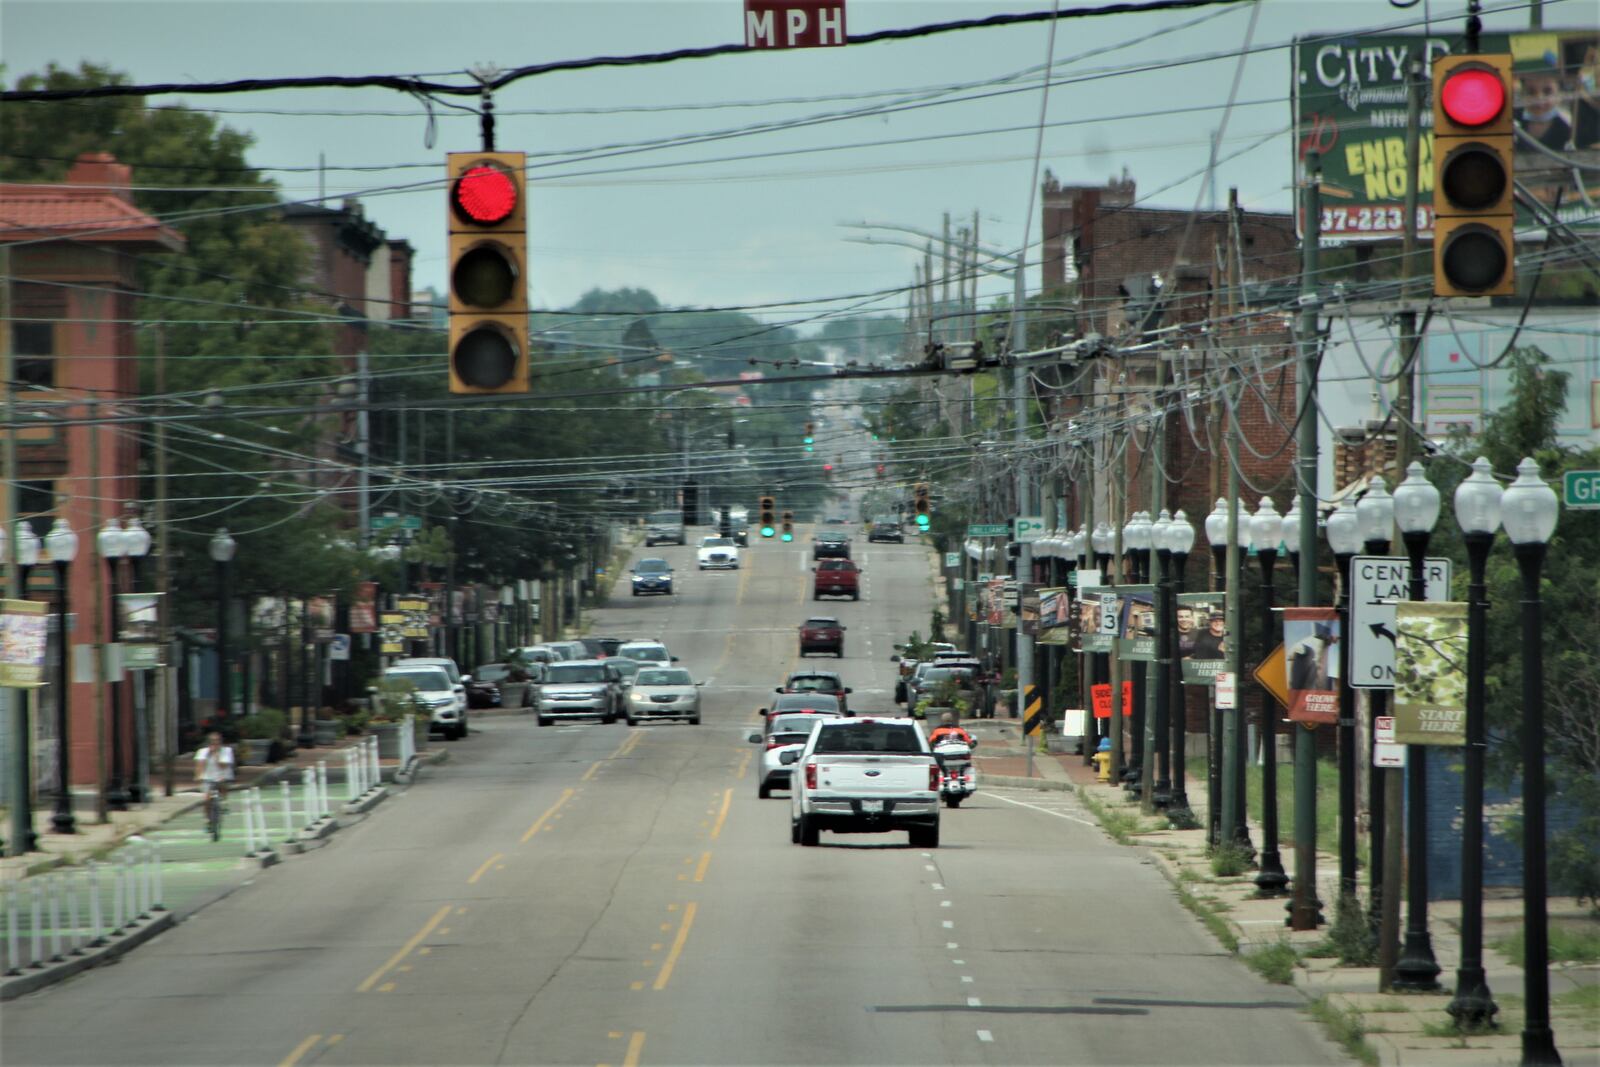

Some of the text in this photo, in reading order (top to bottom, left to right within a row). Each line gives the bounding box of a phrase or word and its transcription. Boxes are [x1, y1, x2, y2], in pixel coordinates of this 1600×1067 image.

[746, 8, 843, 47] MPH
[1316, 45, 1408, 88] CITY
[1370, 109, 1409, 128] DAYTO
[1018, 522, 1030, 538] P
[1361, 565, 1443, 582] CENR
[1373, 583, 1428, 599] LAN
[1095, 686, 1128, 698] SIDELK
[1417, 709, 1465, 721] START
